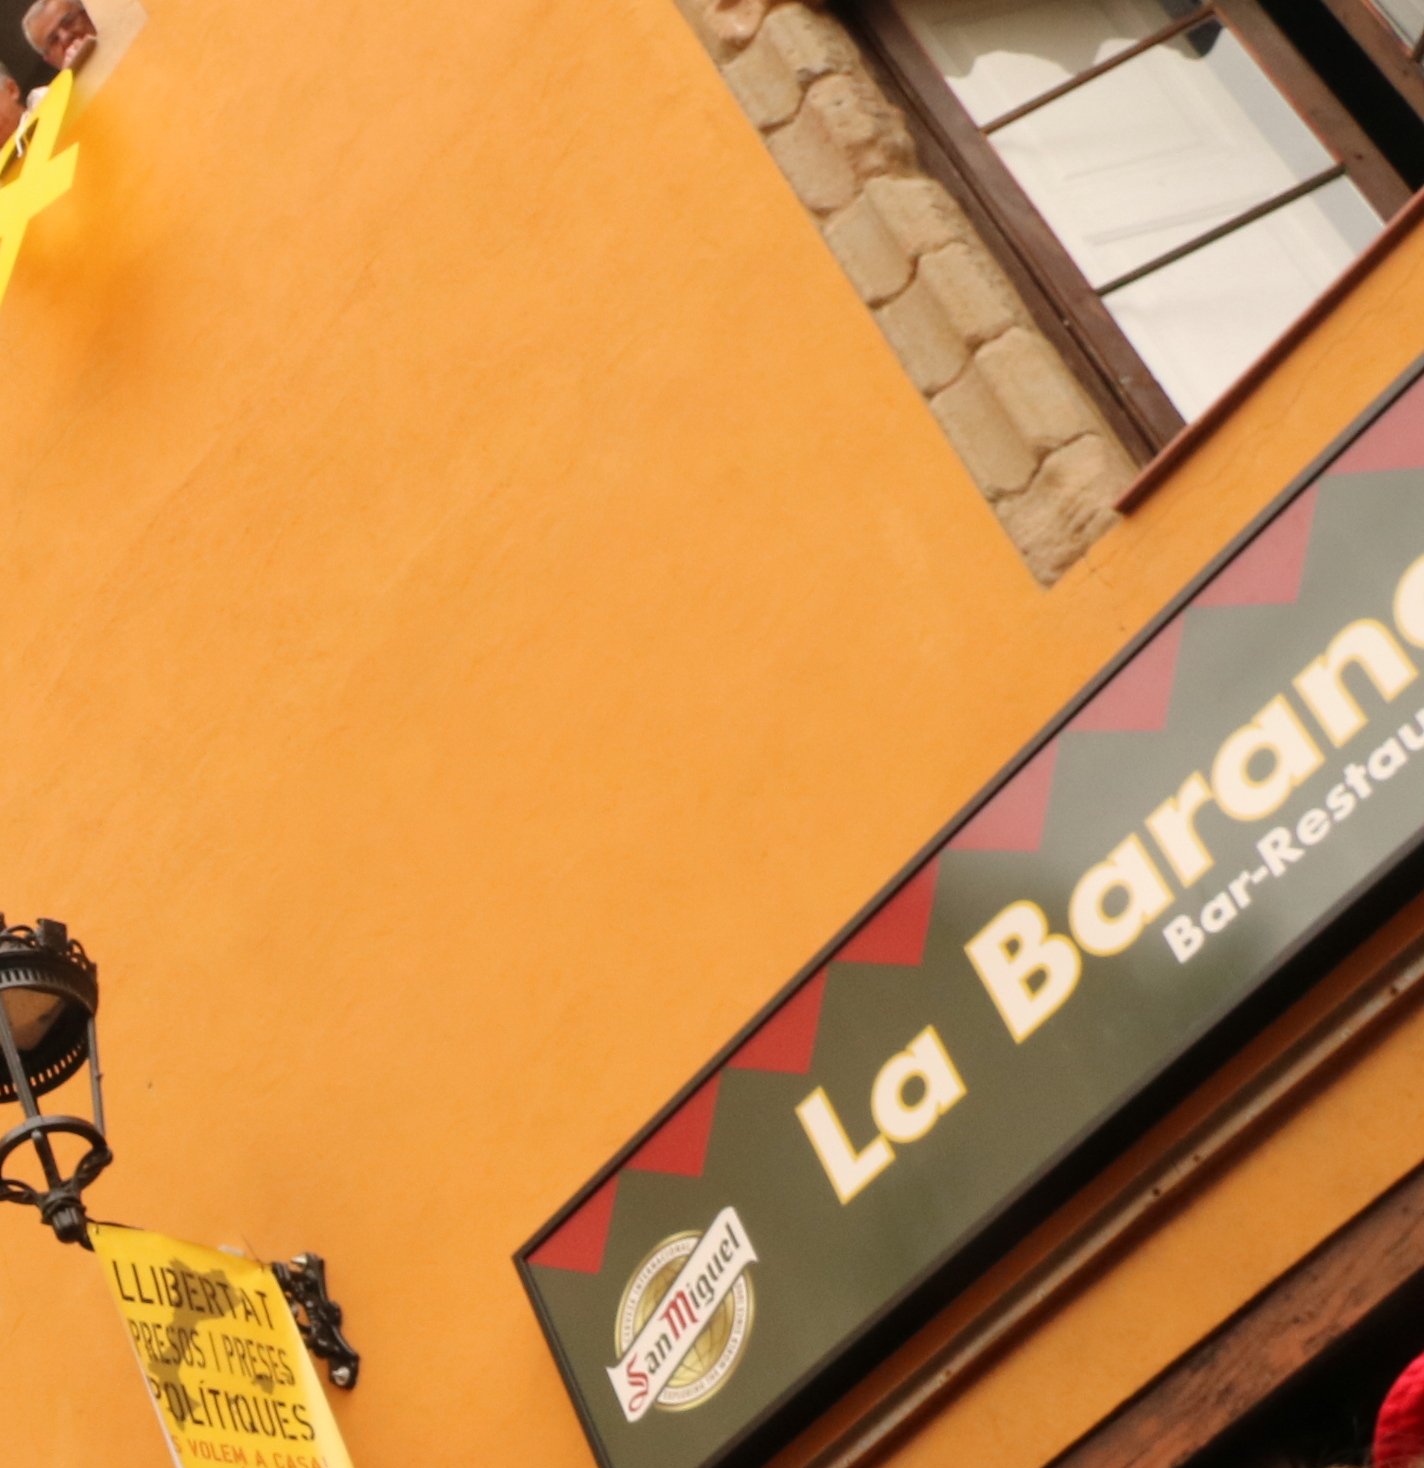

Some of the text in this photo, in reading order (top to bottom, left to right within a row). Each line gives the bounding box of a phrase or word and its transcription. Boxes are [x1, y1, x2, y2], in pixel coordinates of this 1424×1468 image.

[795, 553, 1424, 1205] La Baran
[111, 1259, 276, 1331] LLIBERTAT
[127, 1318, 297, 1387] PRESOS I PRESES
[187, 1439, 248, 1466] VOLEM
[255, 1450, 269, 1468] A
